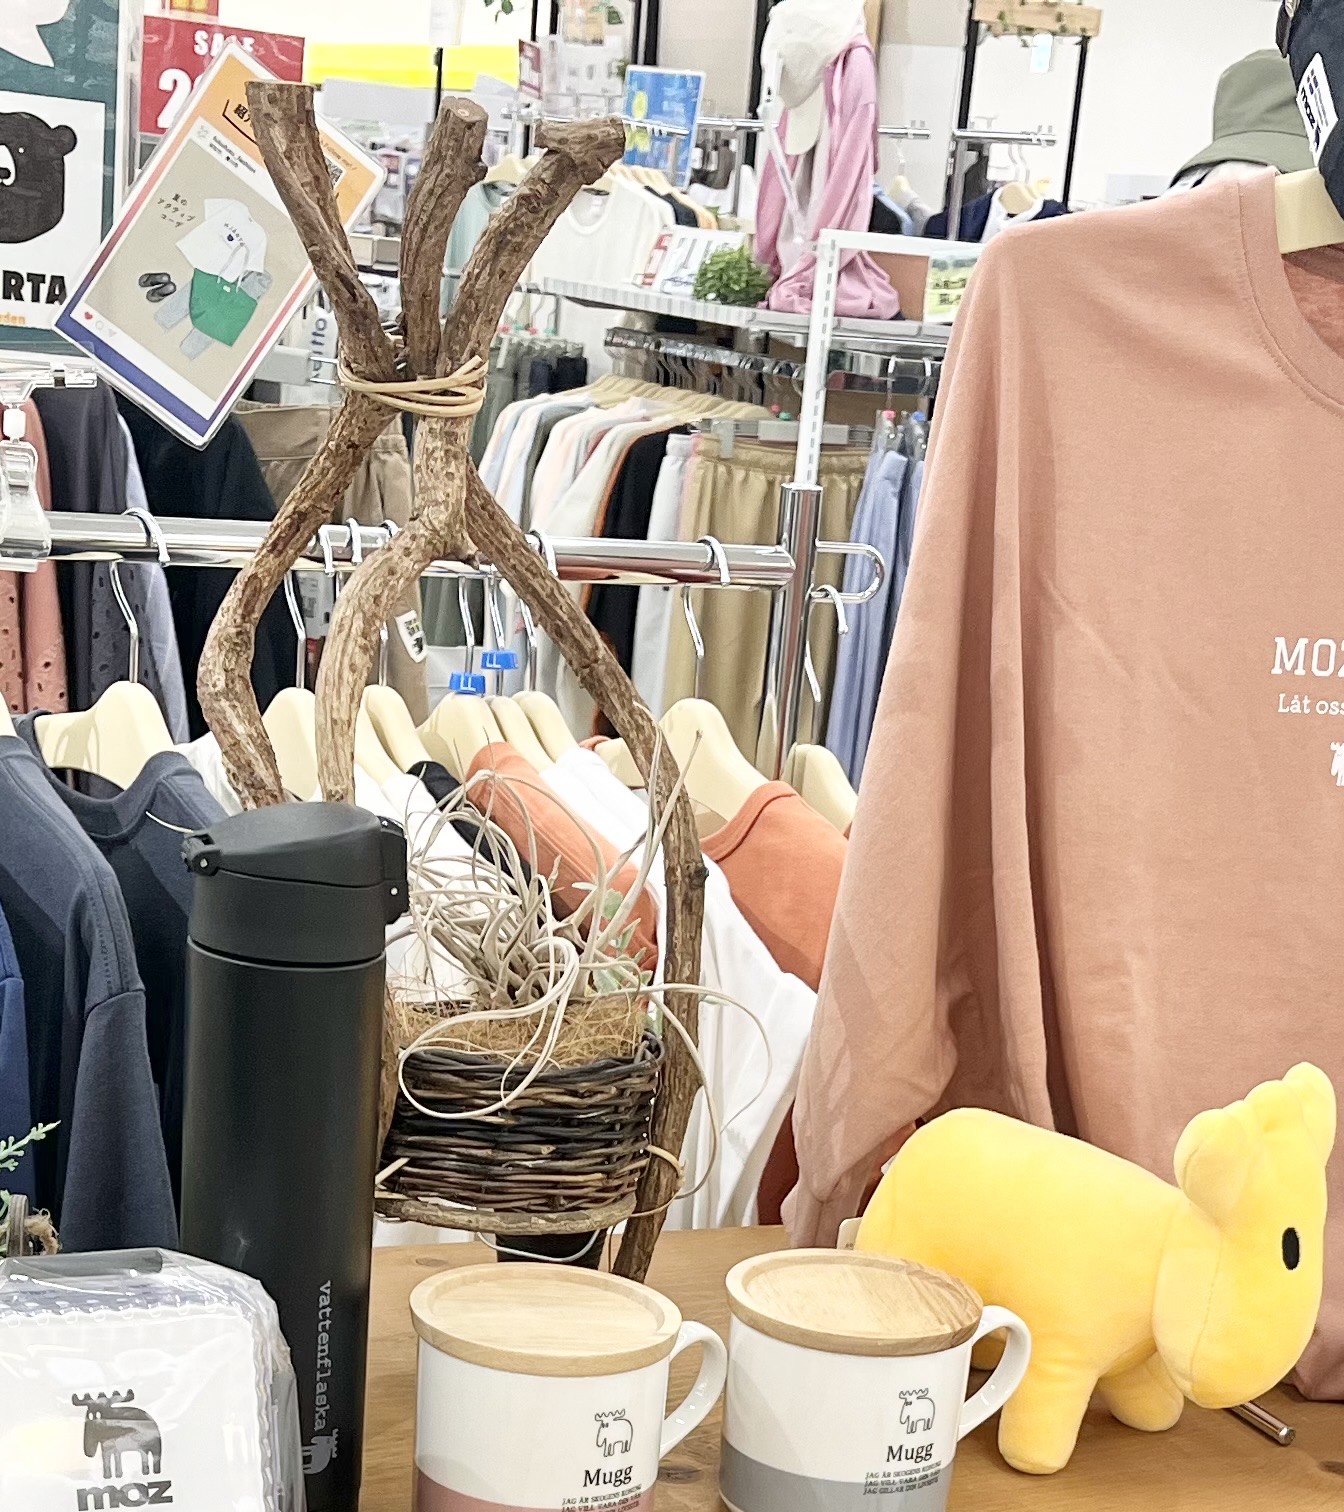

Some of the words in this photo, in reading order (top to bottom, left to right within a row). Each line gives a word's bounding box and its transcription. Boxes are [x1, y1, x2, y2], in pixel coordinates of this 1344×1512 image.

[1277, 693, 1311, 714] Låt
[313, 1279, 333, 1431] vattenflaska
[886, 1442, 935, 1464] Mugg
[583, 1465, 634, 1488] Mugg
[76, 1480, 174, 1512] moz
